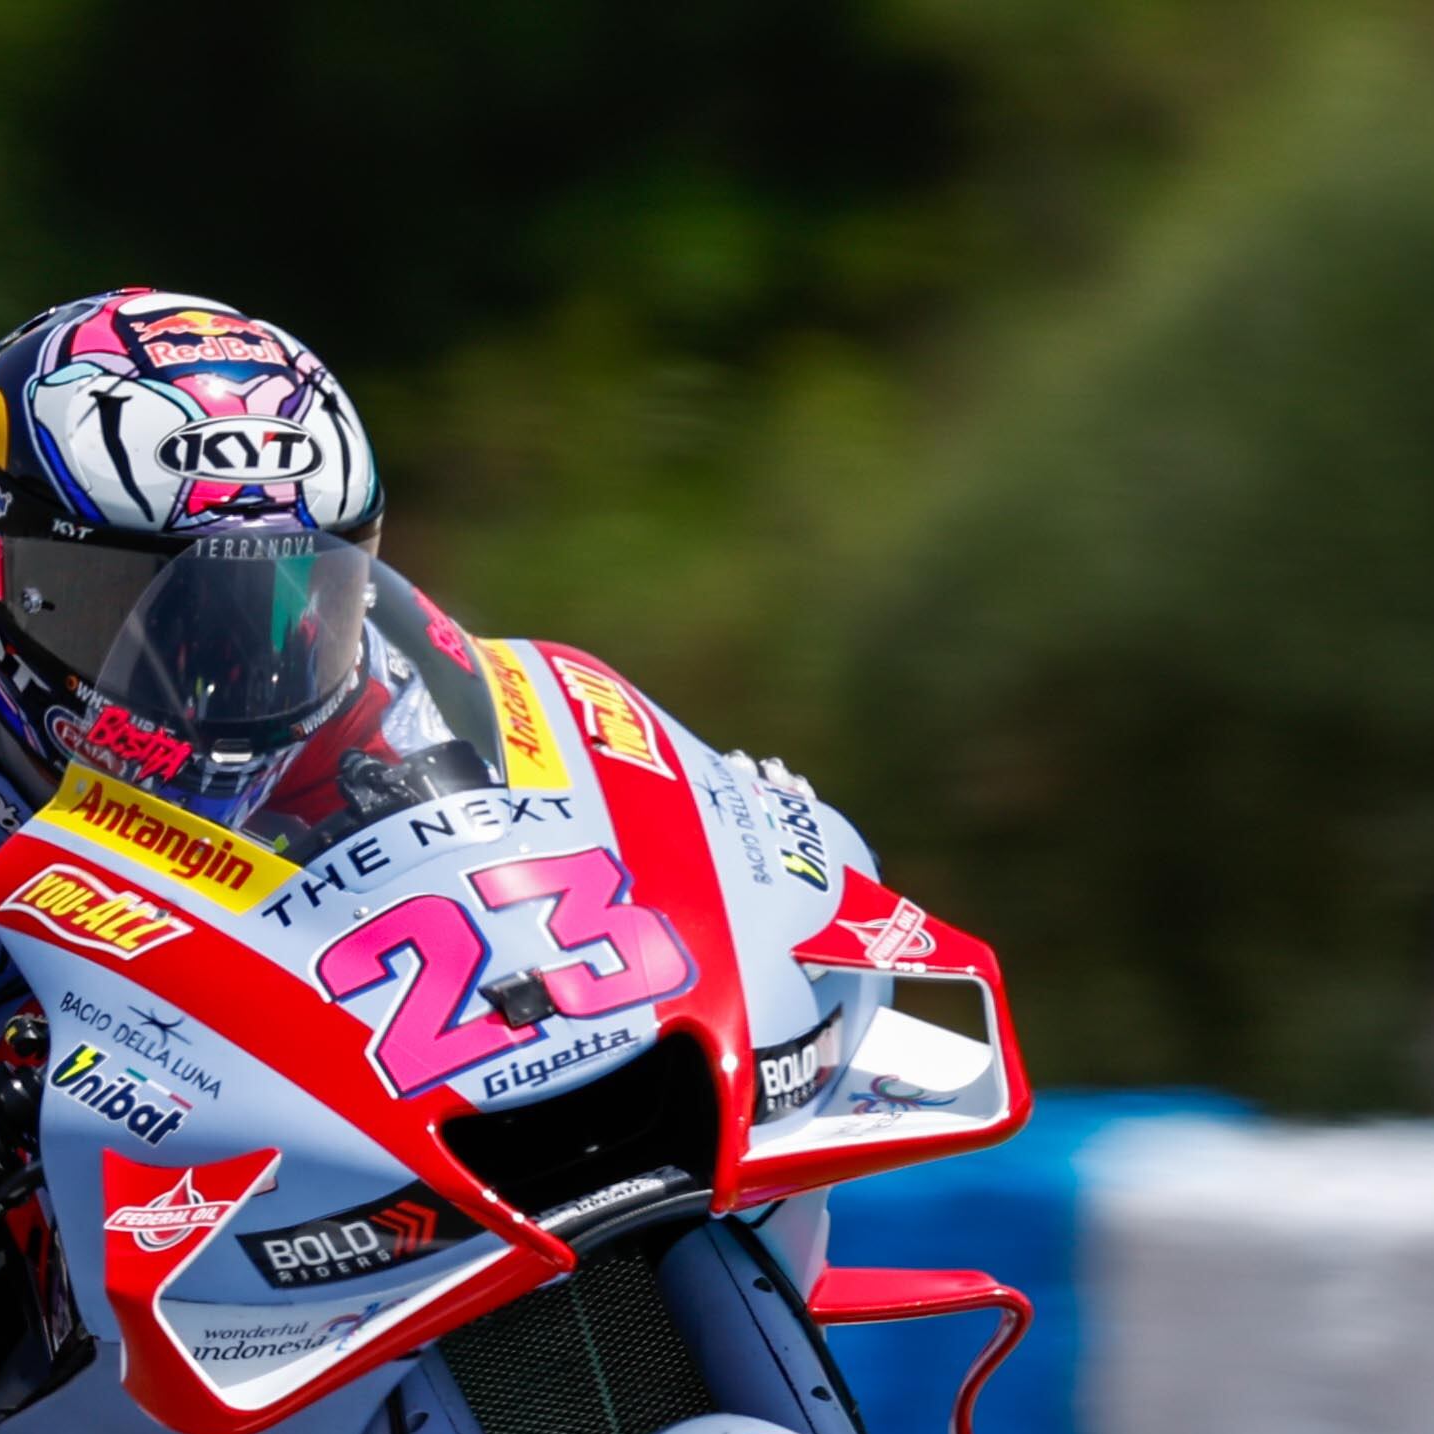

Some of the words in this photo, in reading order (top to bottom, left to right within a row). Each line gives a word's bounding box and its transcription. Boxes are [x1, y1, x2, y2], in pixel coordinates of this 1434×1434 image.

[144, 336, 220, 368] Red
[219, 336, 288, 366] Bull
[176, 431, 309, 472] KYT
[51, 517, 94, 541] KYT
[194, 535, 316, 559] TERRANOVA
[69, 781, 254, 891] Antangin
[262, 836, 391, 928] THE
[408, 796, 574, 848] NEXT
[309, 845, 699, 1101] 23
[60, 991, 113, 1031] BACIO
[113, 1022, 169, 1069] DELLA
[169, 1056, 223, 1100] LUNA
[483, 1026, 641, 1100] Gigetta
[760, 1044, 818, 1097] BOLD
[51, 1042, 185, 1146] Unibat
[114, 1205, 191, 1227] FEDERAL
[192, 1204, 220, 1223] OIL
[264, 1220, 380, 1272] BOLD
[277, 1248, 392, 1284] RIDERS
[203, 1320, 312, 1341] wonderful
